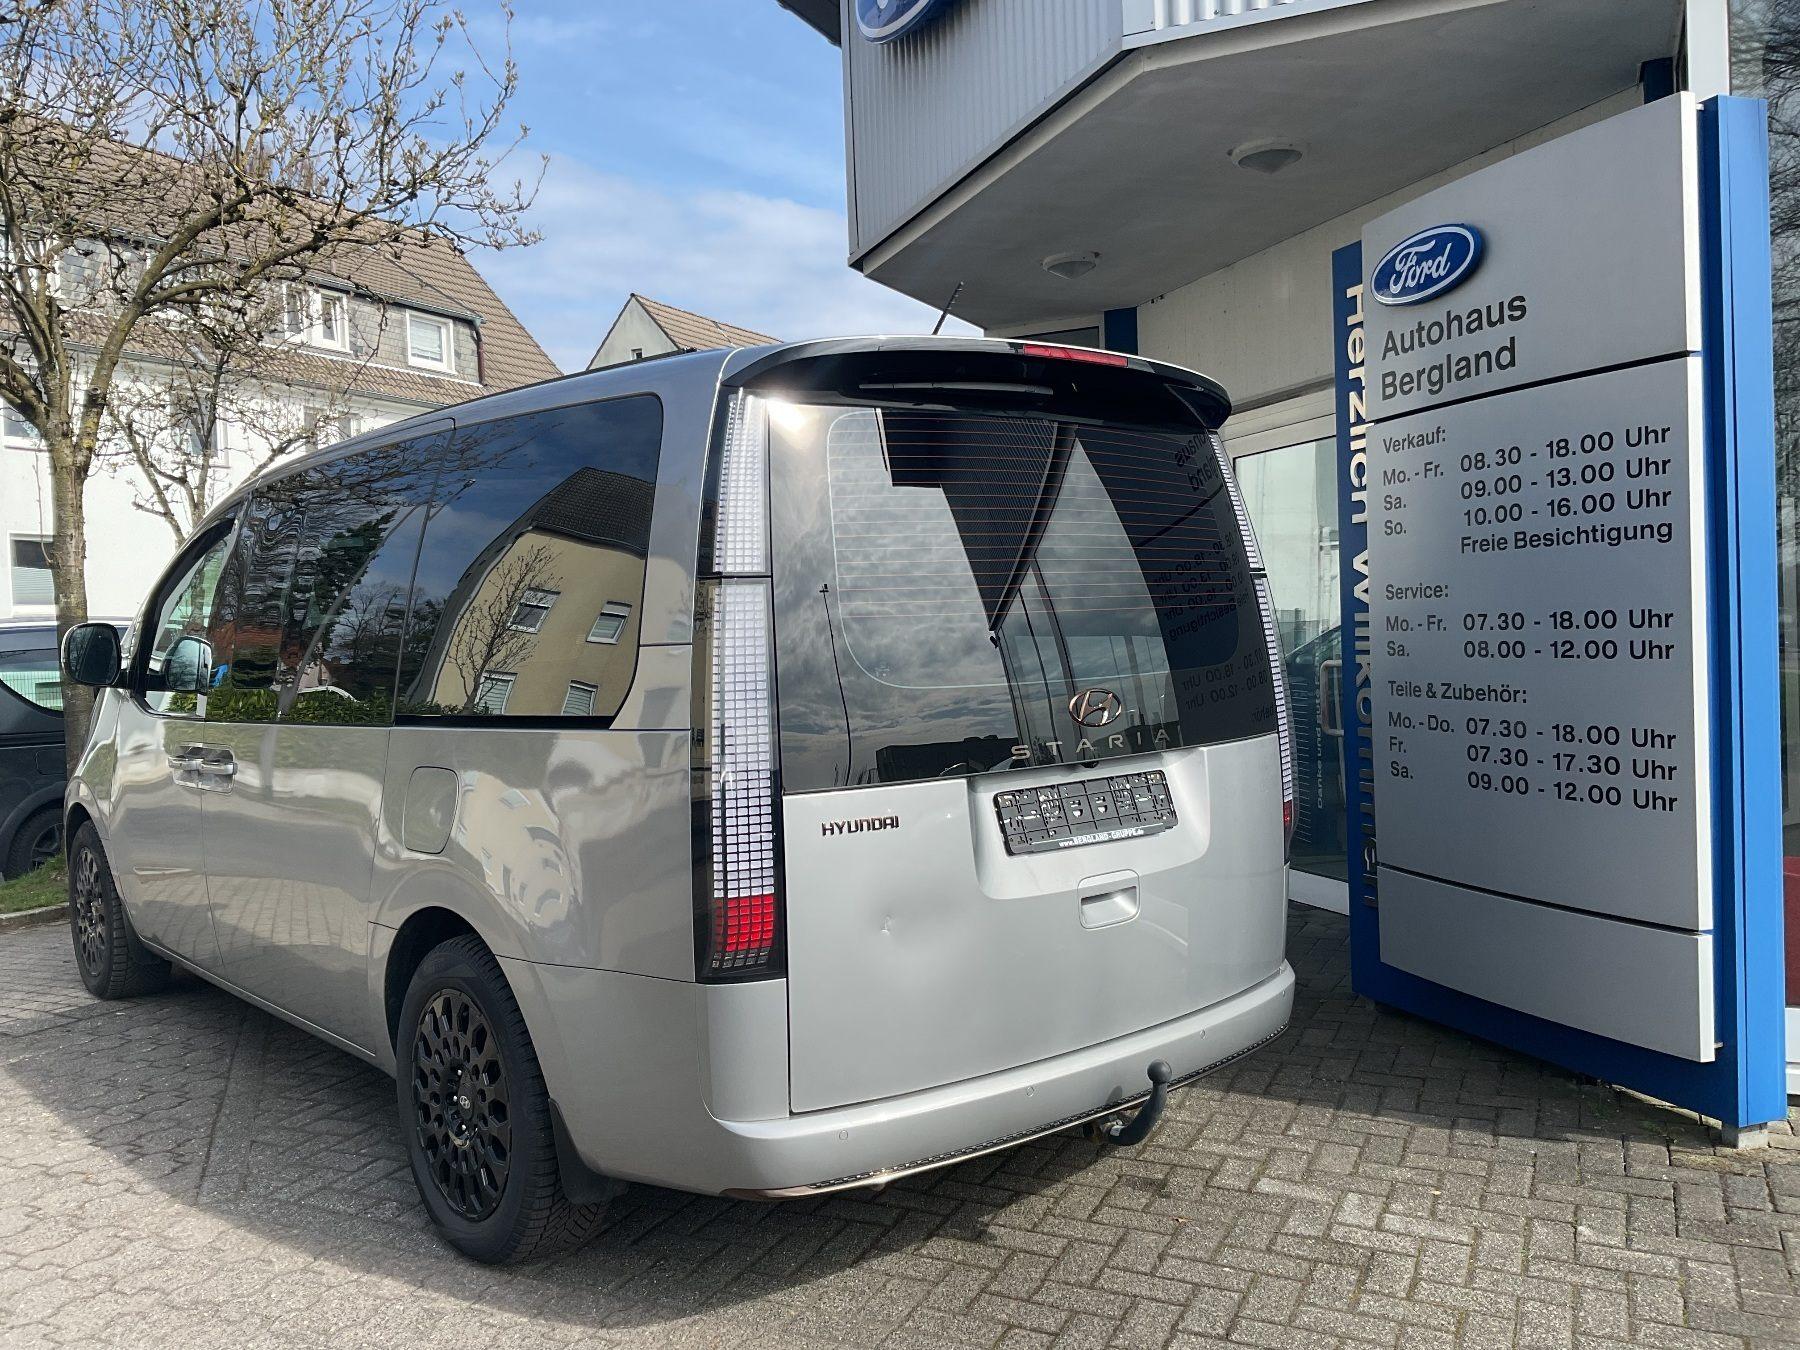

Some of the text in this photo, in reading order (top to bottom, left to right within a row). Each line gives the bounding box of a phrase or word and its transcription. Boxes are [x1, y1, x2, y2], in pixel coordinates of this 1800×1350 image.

[1389, 240, 1452, 294] Ford
[1381, 295, 1527, 360] Autohaus
[1381, 337, 1516, 400] Bergland
[1383, 426, 1445, 453] Verkauf:
[1461, 446, 1521, 472] 08.30
[1546, 432, 1613, 459] 18.00
[1626, 426, 1670, 447] Uhr
[1384, 495, 1406, 511] Sa.
[1461, 475, 1521, 499] 09.00
[1546, 462, 1614, 488] 13.00
[1626, 457, 1671, 478] Uhr
[1385, 520, 1406, 536] So.
[1464, 503, 1522, 526] 10.00
[1547, 493, 1615, 517] 16.00
[1627, 489, 1671, 509] Uhr
[1461, 523, 1672, 554] Freie Besichtigung
[1386, 583, 1448, 600] Service:
[1464, 612, 1524, 631] 07.30
[1549, 610, 1617, 629] 18.00
[1629, 609, 1673, 628] Uhr
[1387, 641, 1409, 656] Sa.
[1464, 641, 1525, 658] 08.00
[1550, 640, 1617, 659] 12.00
[1630, 640, 1674, 659] Uhr
[1388, 681, 1526, 703] Teile & Zubehör:
[1011, 728, 1170, 760] STARIA
[1466, 718, 1526, 738] 07.30
[1552, 724, 1620, 745] 18.00
[1632, 728, 1676, 749] Uhr
[1390, 736, 1406, 753] Fr.
[1467, 745, 1528, 766] 07.30
[1553, 753, 1620, 775] 17.30
[1633, 759, 1677, 780] Uhr
[1391, 761, 1413, 779] Sa.
[1468, 772, 1529, 795] 09.00
[1553, 782, 1621, 806] 12.00
[1633, 789, 1677, 812] Uhr
[821, 814, 900, 837] HYUNDAI
